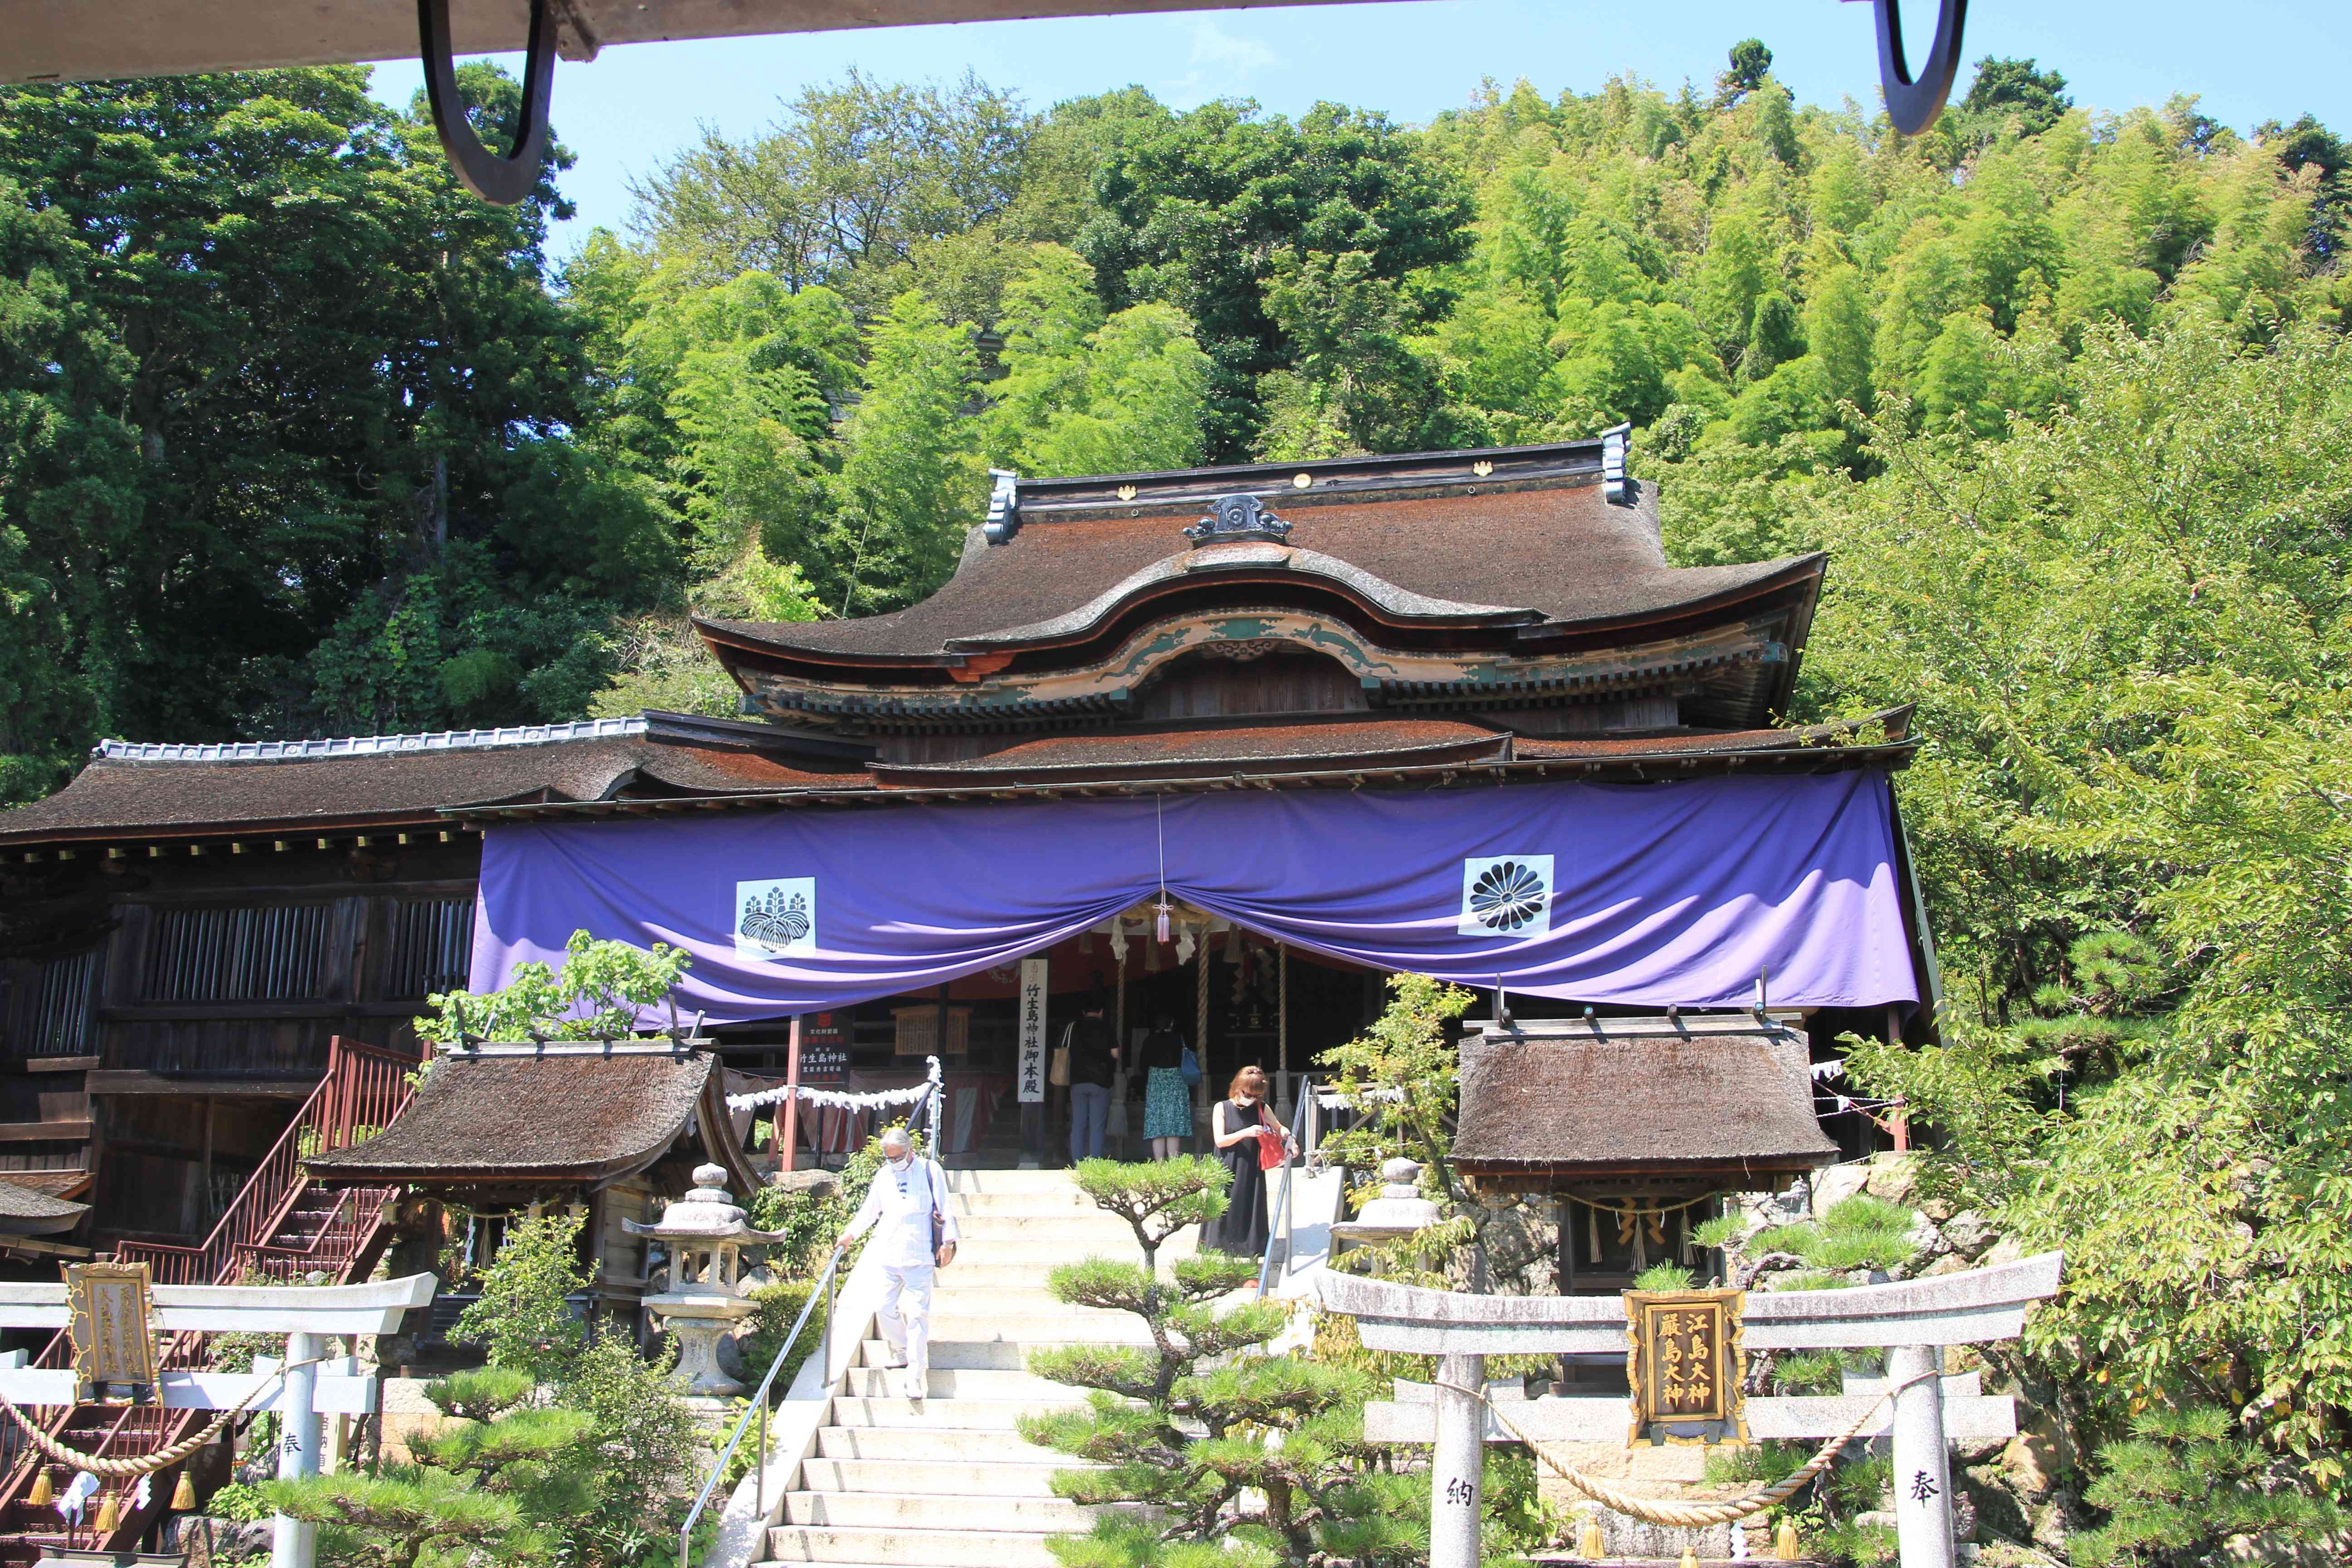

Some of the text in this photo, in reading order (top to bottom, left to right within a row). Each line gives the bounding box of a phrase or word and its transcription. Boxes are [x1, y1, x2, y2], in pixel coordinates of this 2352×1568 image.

[1023, 983, 1040, 1094] 竹生島神社御本殿
[1686, 1313, 1711, 1409] 江島大神
[283, 1432, 303, 1458] 奉
[1446, 1477, 1474, 1506] 納
[1911, 1470, 1940, 1509] 奉
